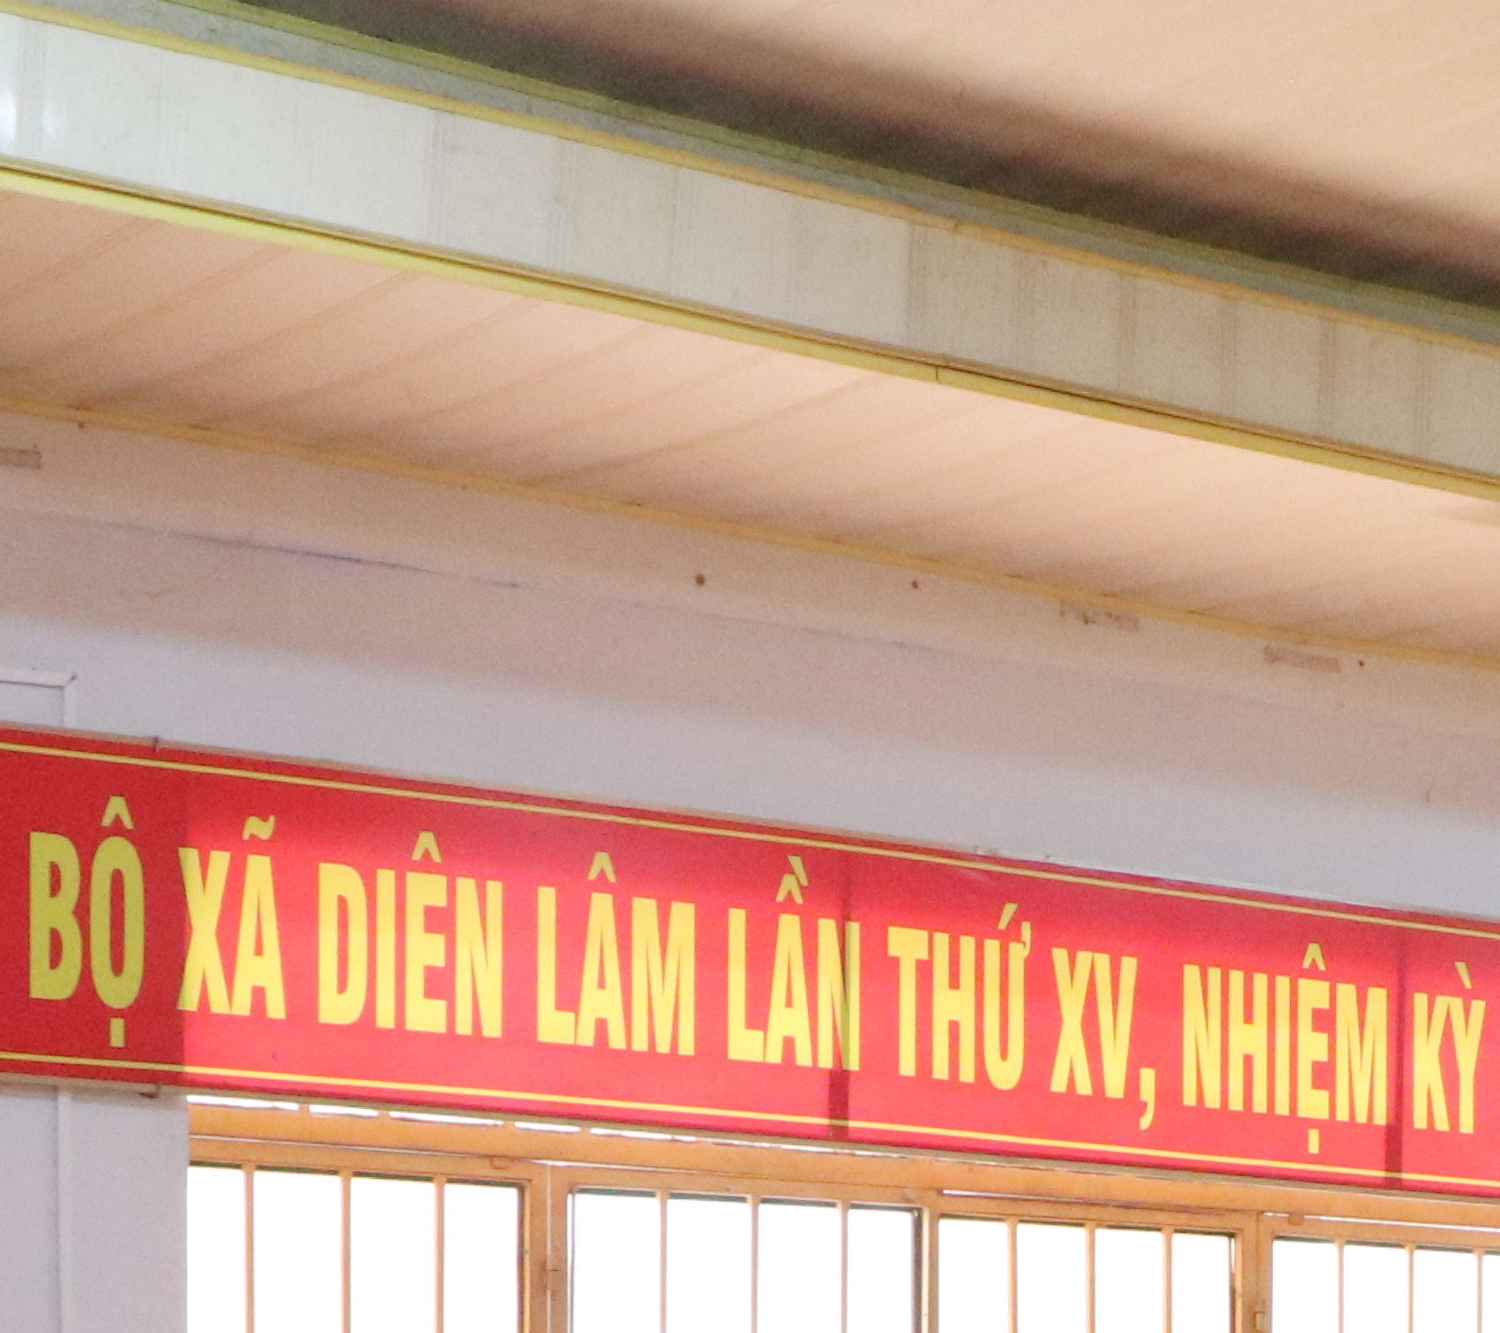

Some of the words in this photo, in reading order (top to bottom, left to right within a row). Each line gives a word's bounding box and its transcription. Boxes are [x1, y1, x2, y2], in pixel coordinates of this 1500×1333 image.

[28, 795, 146, 1048] BỘ
[178, 815, 287, 1020] XÃ
[317, 831, 503, 1039] DIÊN
[536, 851, 695, 1057] LÂM
[727, 854, 861, 1072] LẦN
[887, 902, 1032, 1091] THỨ
[1049, 946, 1156, 1131] XV,
[1181, 943, 1388, 1154] NHIỆM
[1412, 961, 1486, 1135] KỲ
